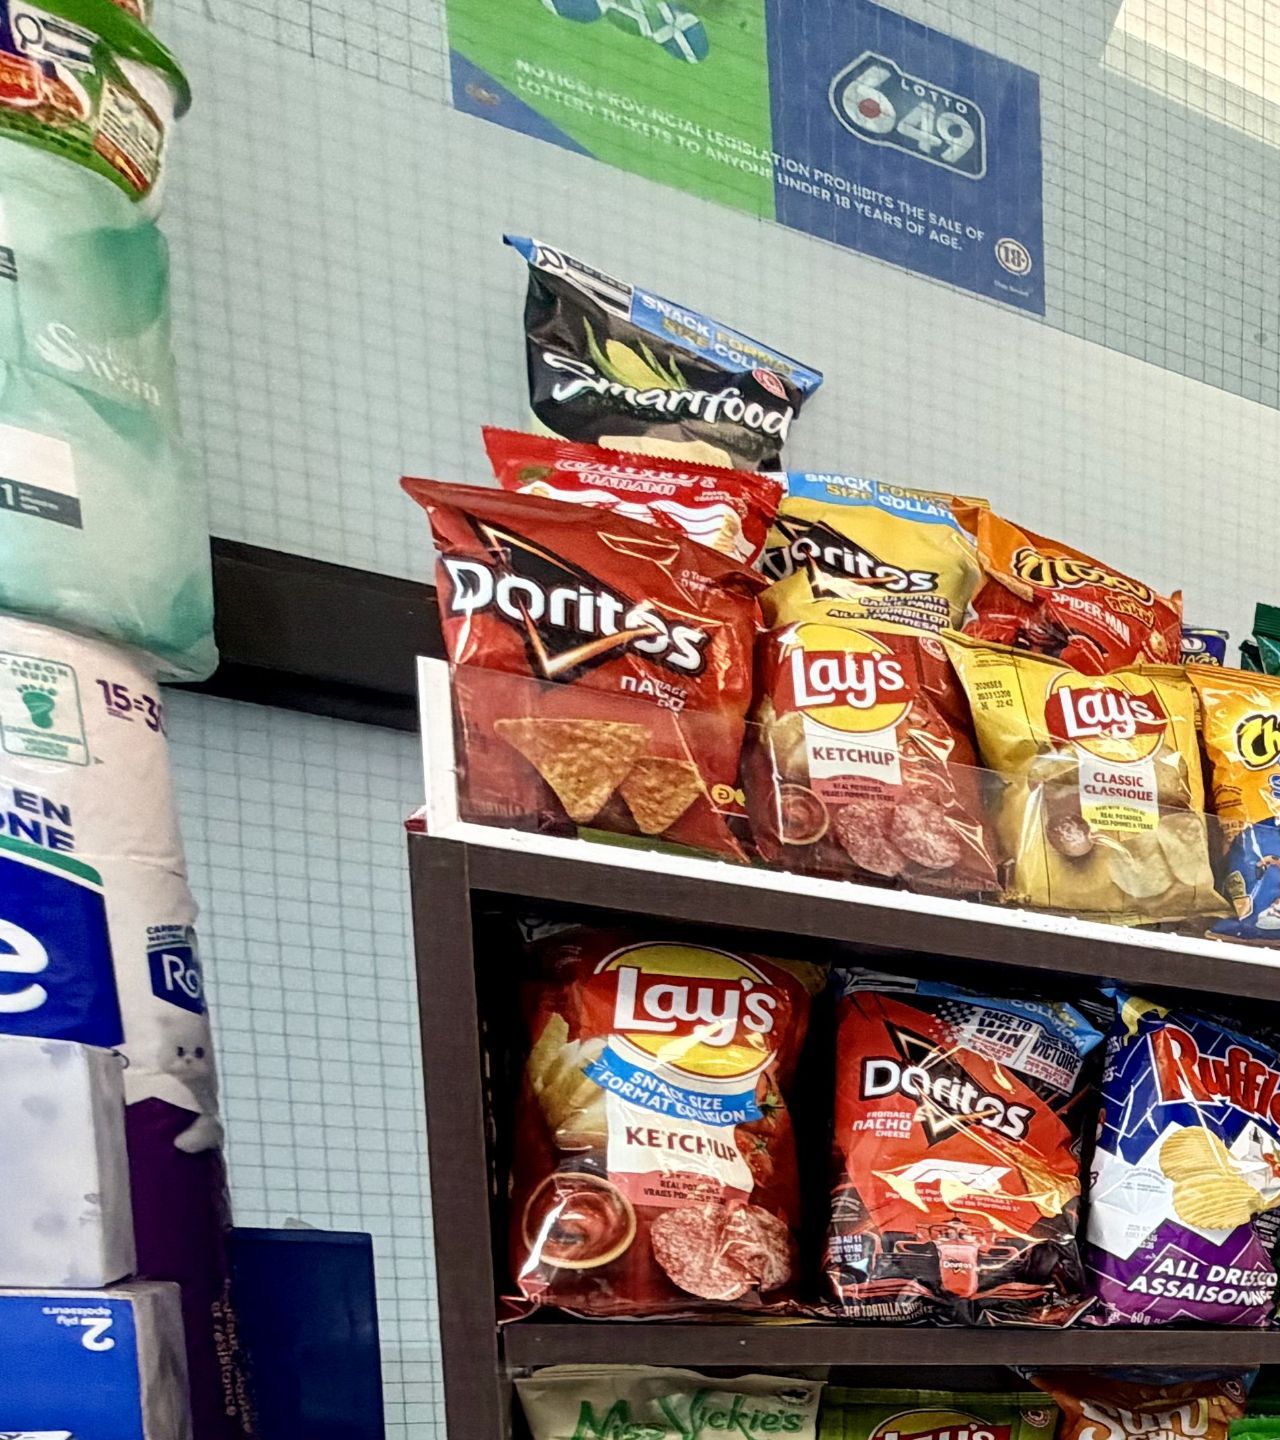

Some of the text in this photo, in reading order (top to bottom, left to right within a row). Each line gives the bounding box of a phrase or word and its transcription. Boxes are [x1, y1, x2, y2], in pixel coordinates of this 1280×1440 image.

[899, 79, 969, 115] LOTTO
[676, 135, 701, 154] TO
[778, 172, 832, 203] UNDER
[835, 191, 851, 210] 18
[854, 199, 904, 230] YEARS
[906, 219, 927, 237] OF
[928, 226, 964, 252] AGE.
[706, 128, 810, 175] LEGISLATION
[814, 168, 894, 210] PROHIBITS
[897, 198, 925, 218] THE
[928, 209, 962, 231] SALE
[965, 223, 986, 242] OF
[542, 352, 793, 441] Smartfood
[805, 473, 872, 492] SNACK
[445, 557, 707, 673] Doritos
[792, 646, 904, 709] Lay's
[1059, 686, 1157, 739] Lay's
[812, 746, 896, 767] KETCHUP
[1084, 784, 1154, 803] CLASSIQUE
[1093, 772, 1145, 788] CLASSIC
[613, 966, 779, 1047] Lay's
[689, 1093, 724, 1112] SIZE
[863, 1058, 1032, 1141] Doritos
[625, 1126, 739, 1163] KETCHUP
[875, 1130, 911, 1139] CHEESE
[1155, 1257, 1199, 1279] ALL
[81, 1318, 115, 1352] 2
